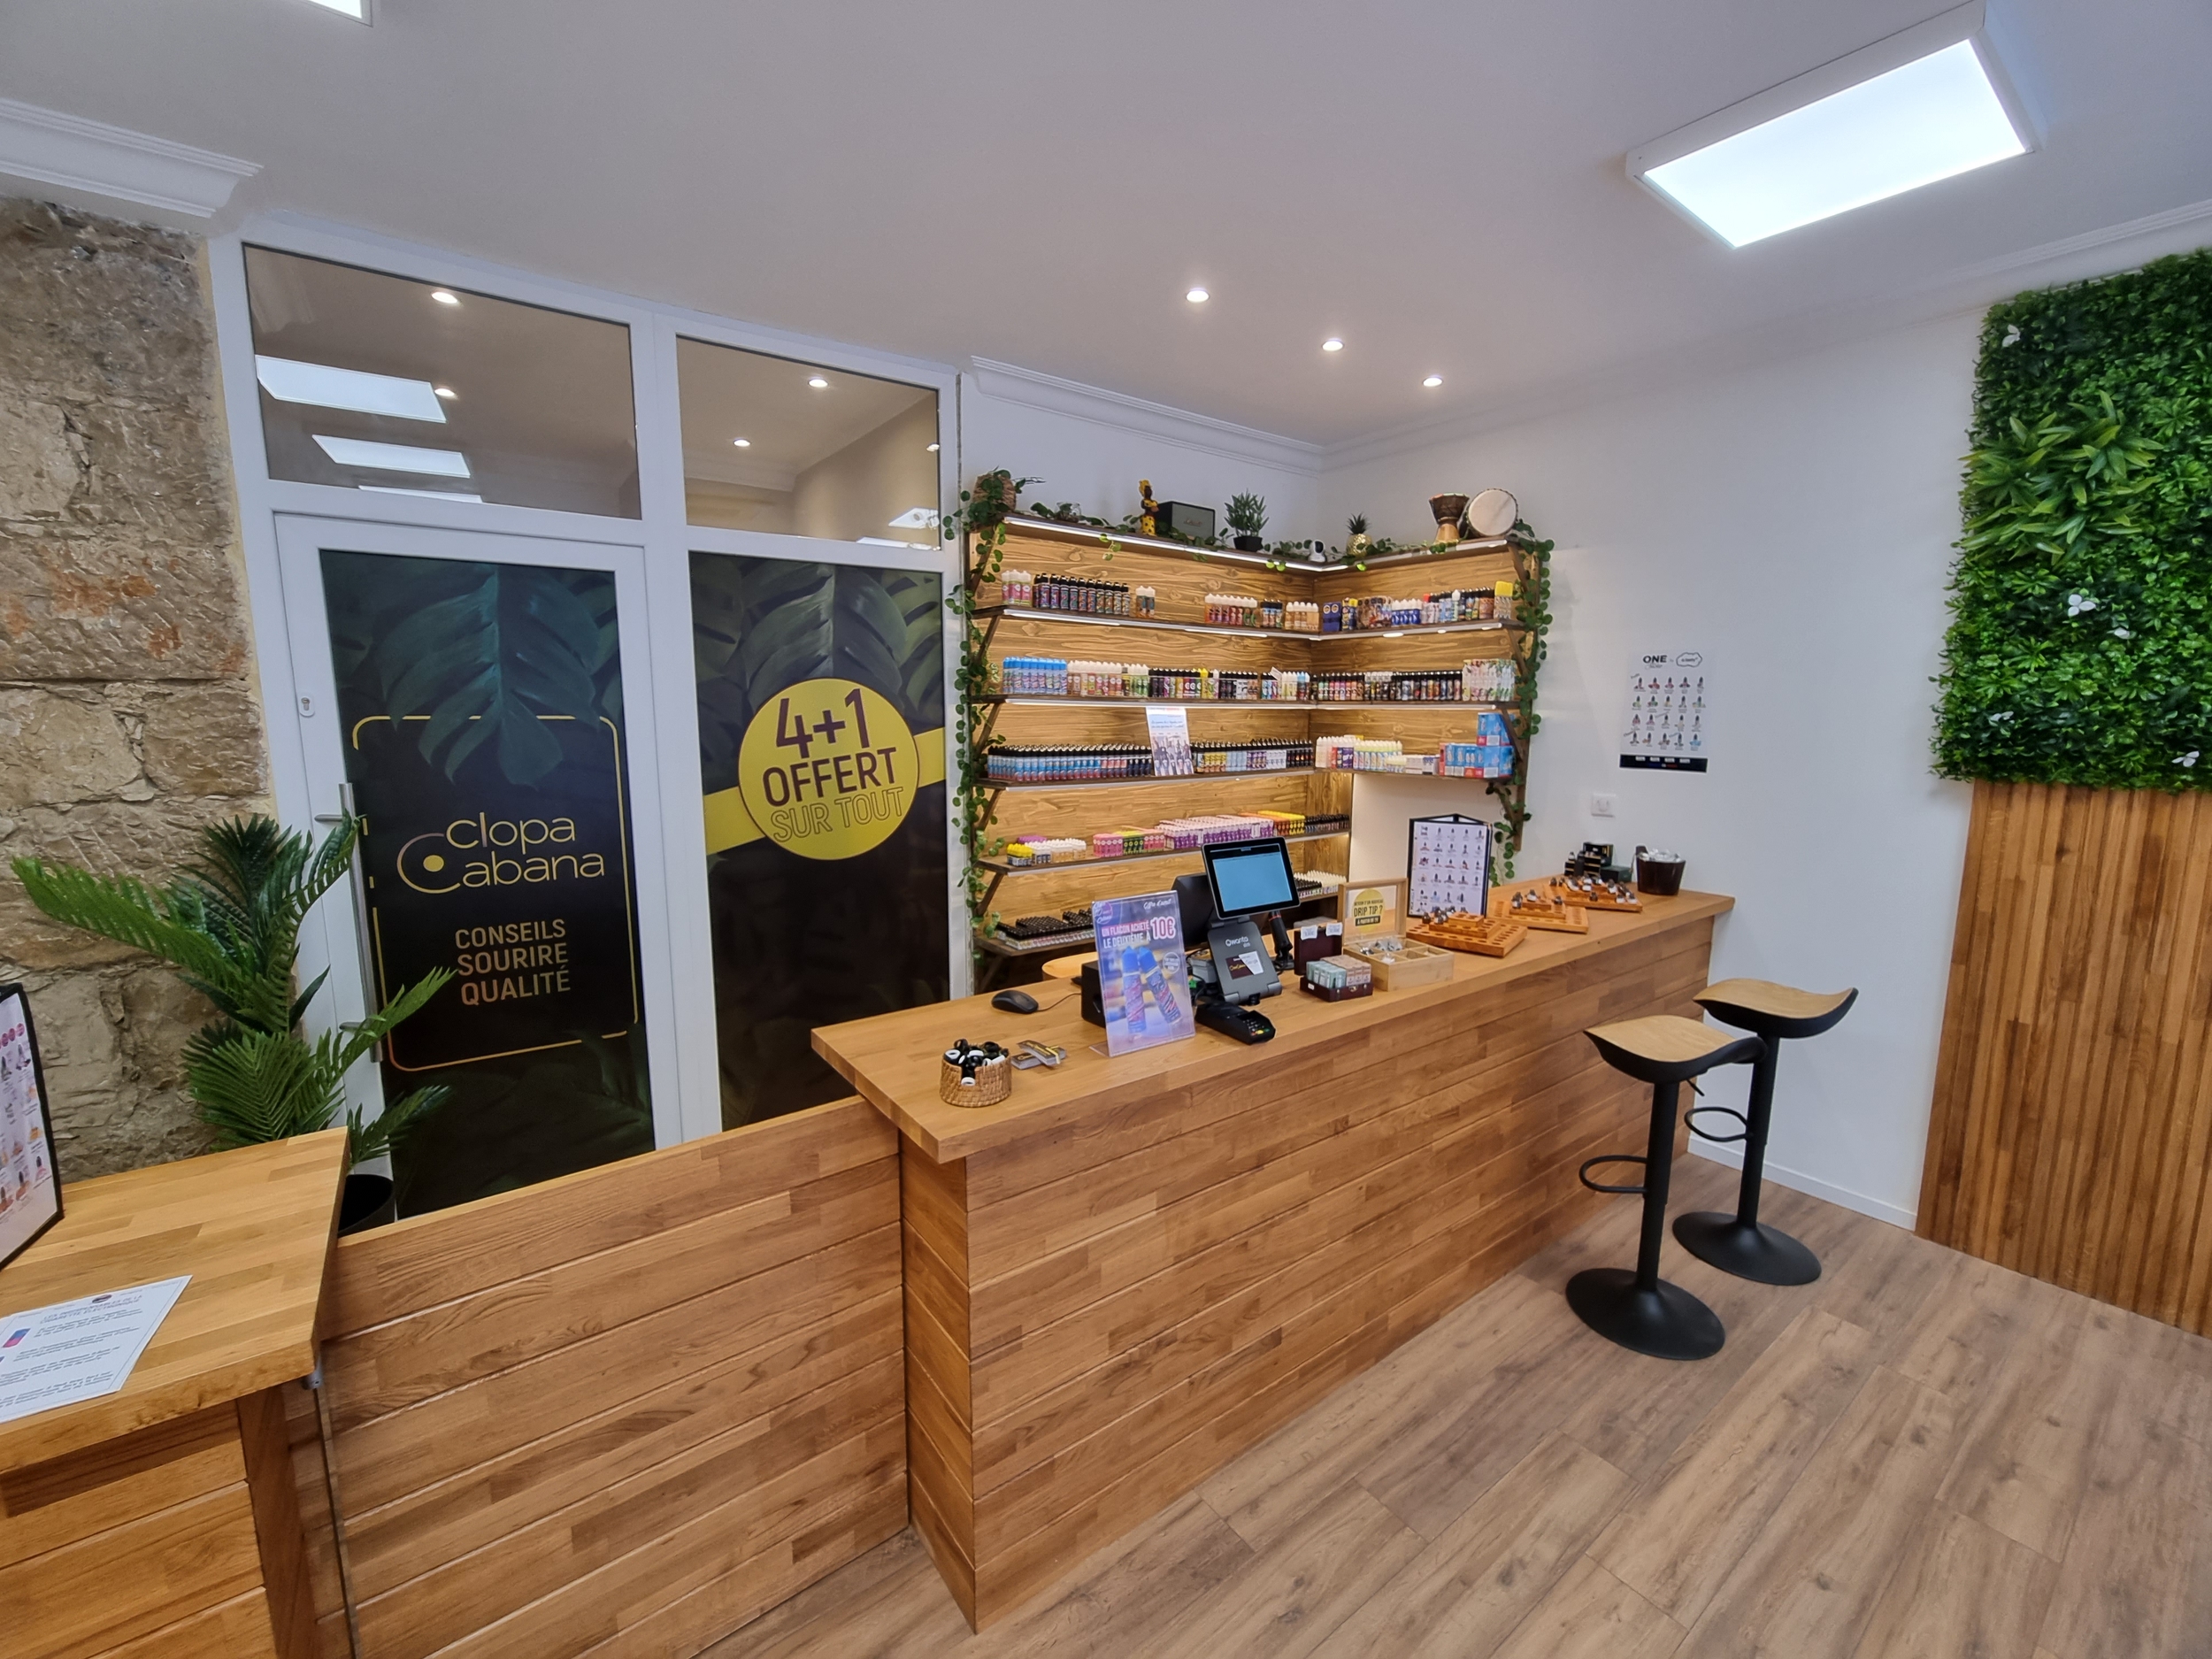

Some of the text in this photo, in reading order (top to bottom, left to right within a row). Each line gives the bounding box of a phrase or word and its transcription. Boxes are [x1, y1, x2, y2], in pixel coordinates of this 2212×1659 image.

[1643, 655, 1667, 664] ONE
[775, 687, 870, 758] 4+1
[763, 747, 896, 807] OFFERT
[771, 787, 903, 842] SUR TOUT
[1354, 907, 1368, 918] DRIP
[1369, 905, 1378, 915] TIP
[455, 918, 566, 949] CONSEILS
[1103, 938, 1111, 949] LE
[1112, 932, 1144, 948] DEUXIÈME
[1110, 925, 1130, 936] FLACON
[1150, 916, 1176, 940] 10€
[457, 942, 569, 976] SOURIRE
[461, 964, 571, 1006] QUALITÉ
